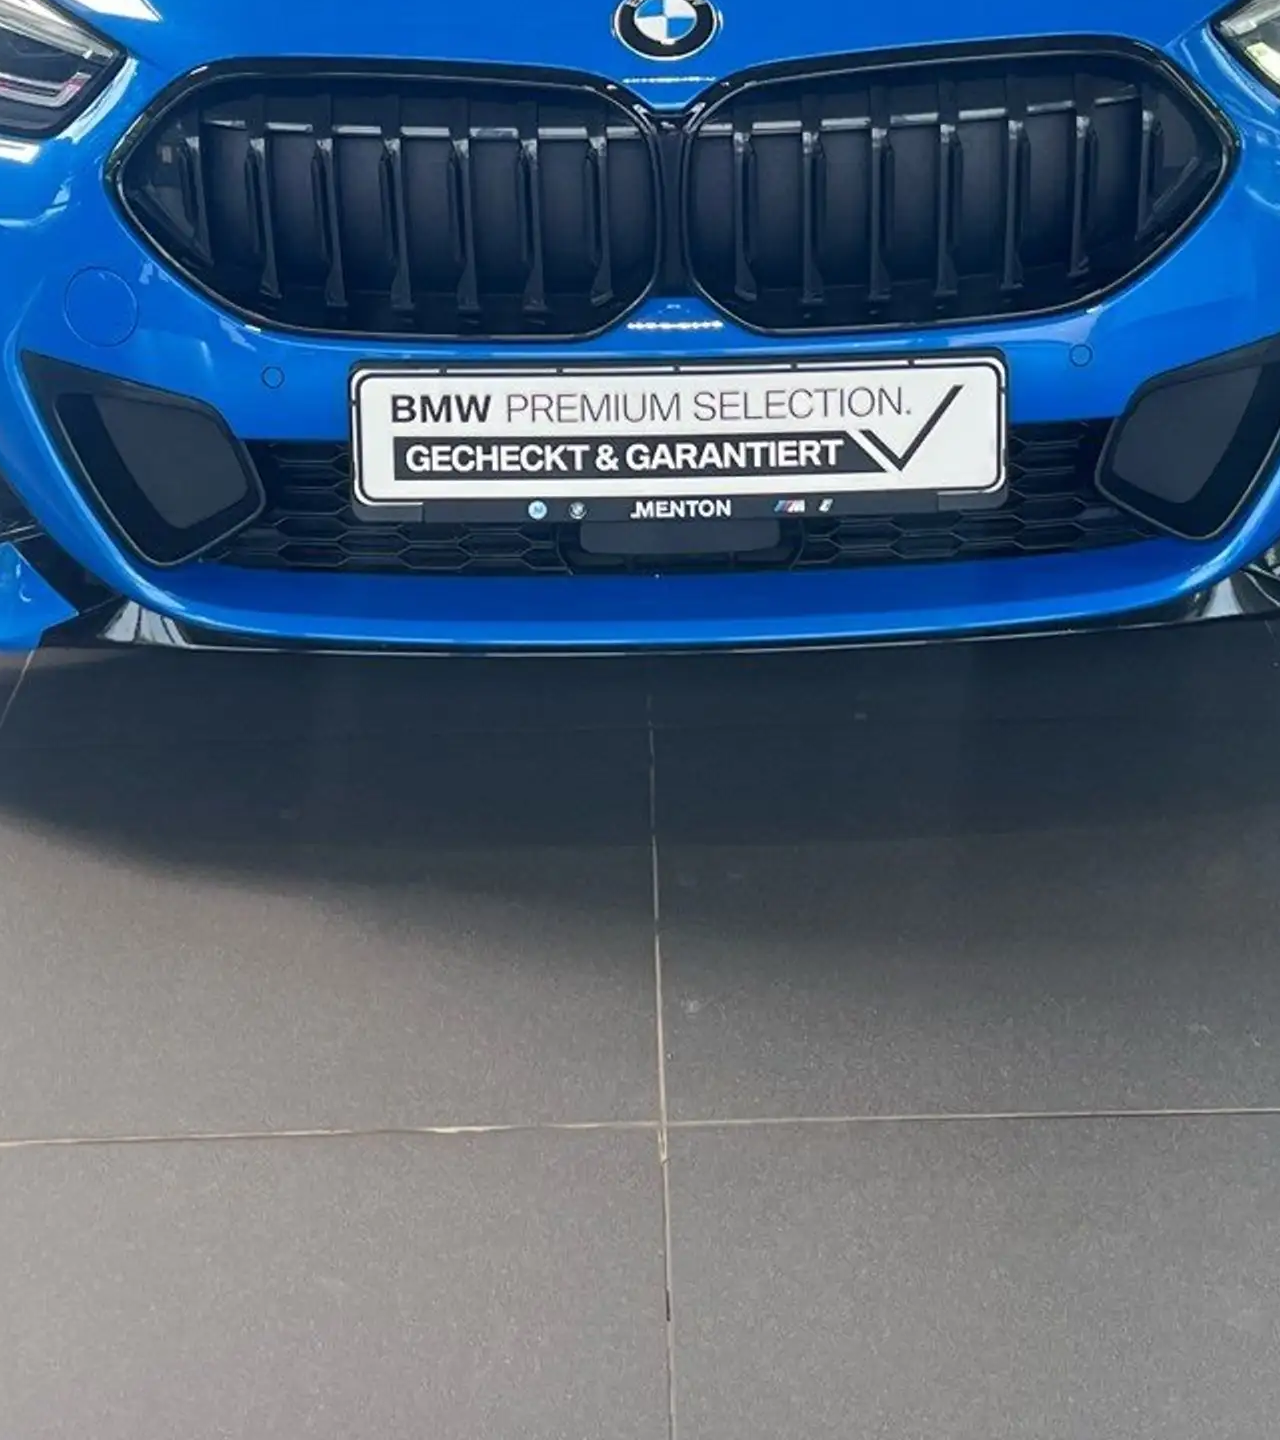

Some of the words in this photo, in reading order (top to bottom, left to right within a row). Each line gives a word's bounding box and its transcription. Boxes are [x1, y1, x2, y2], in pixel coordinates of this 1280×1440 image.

[391, 394, 491, 424] BMW
[506, 391, 682, 423] PREMIUM
[693, 386, 912, 422] SELECTION.
[405, 443, 590, 472] GECHECKT
[594, 443, 620, 472] &
[625, 438, 844, 471] GARANTIERT
